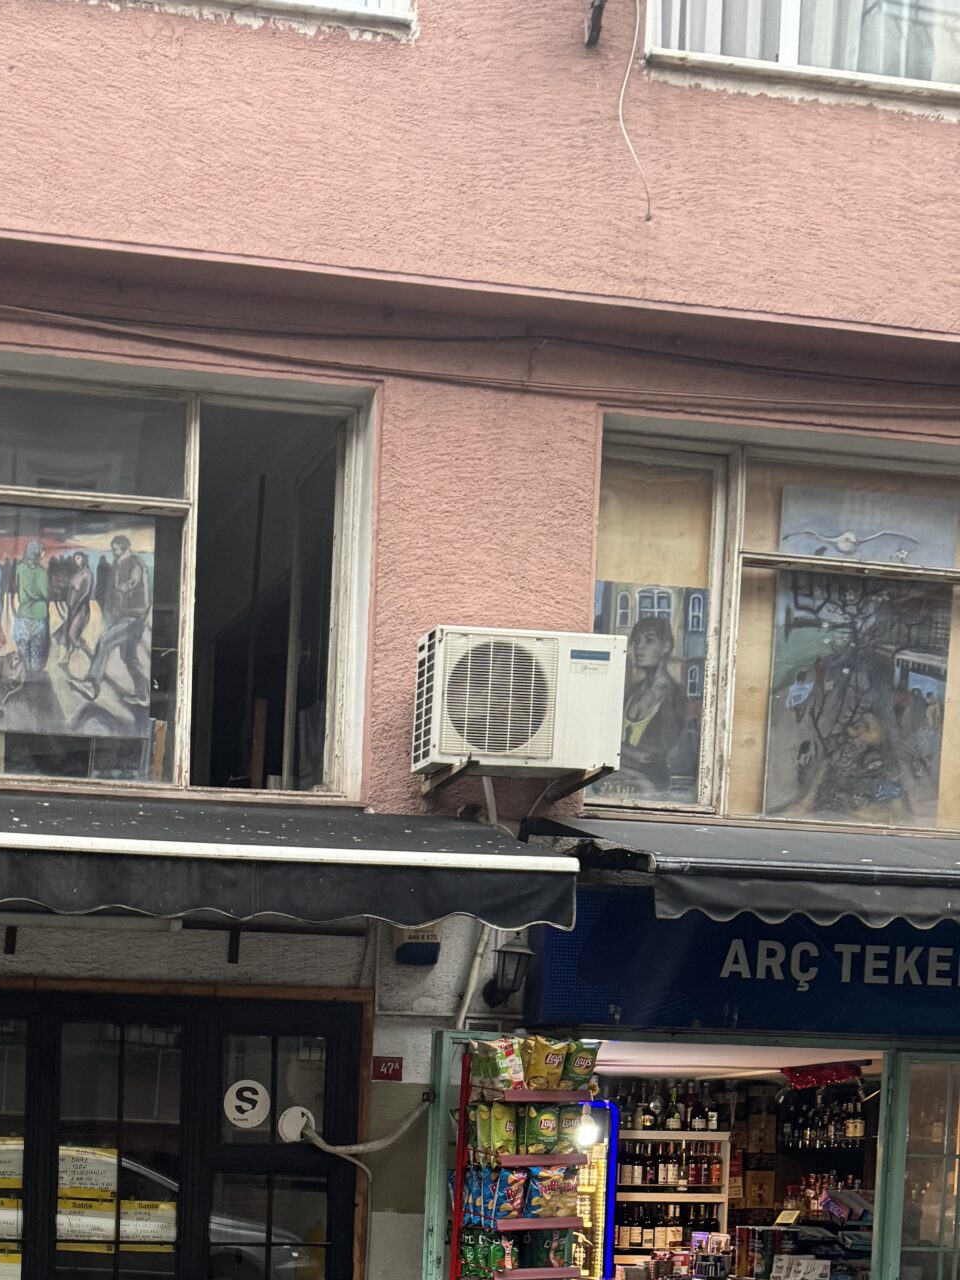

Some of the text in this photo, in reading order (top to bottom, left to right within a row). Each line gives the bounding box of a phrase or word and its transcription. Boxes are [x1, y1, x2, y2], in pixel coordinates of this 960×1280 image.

[720, 938, 960, 992] ARÇ TEKE
[234, 1086, 259, 1115] S
